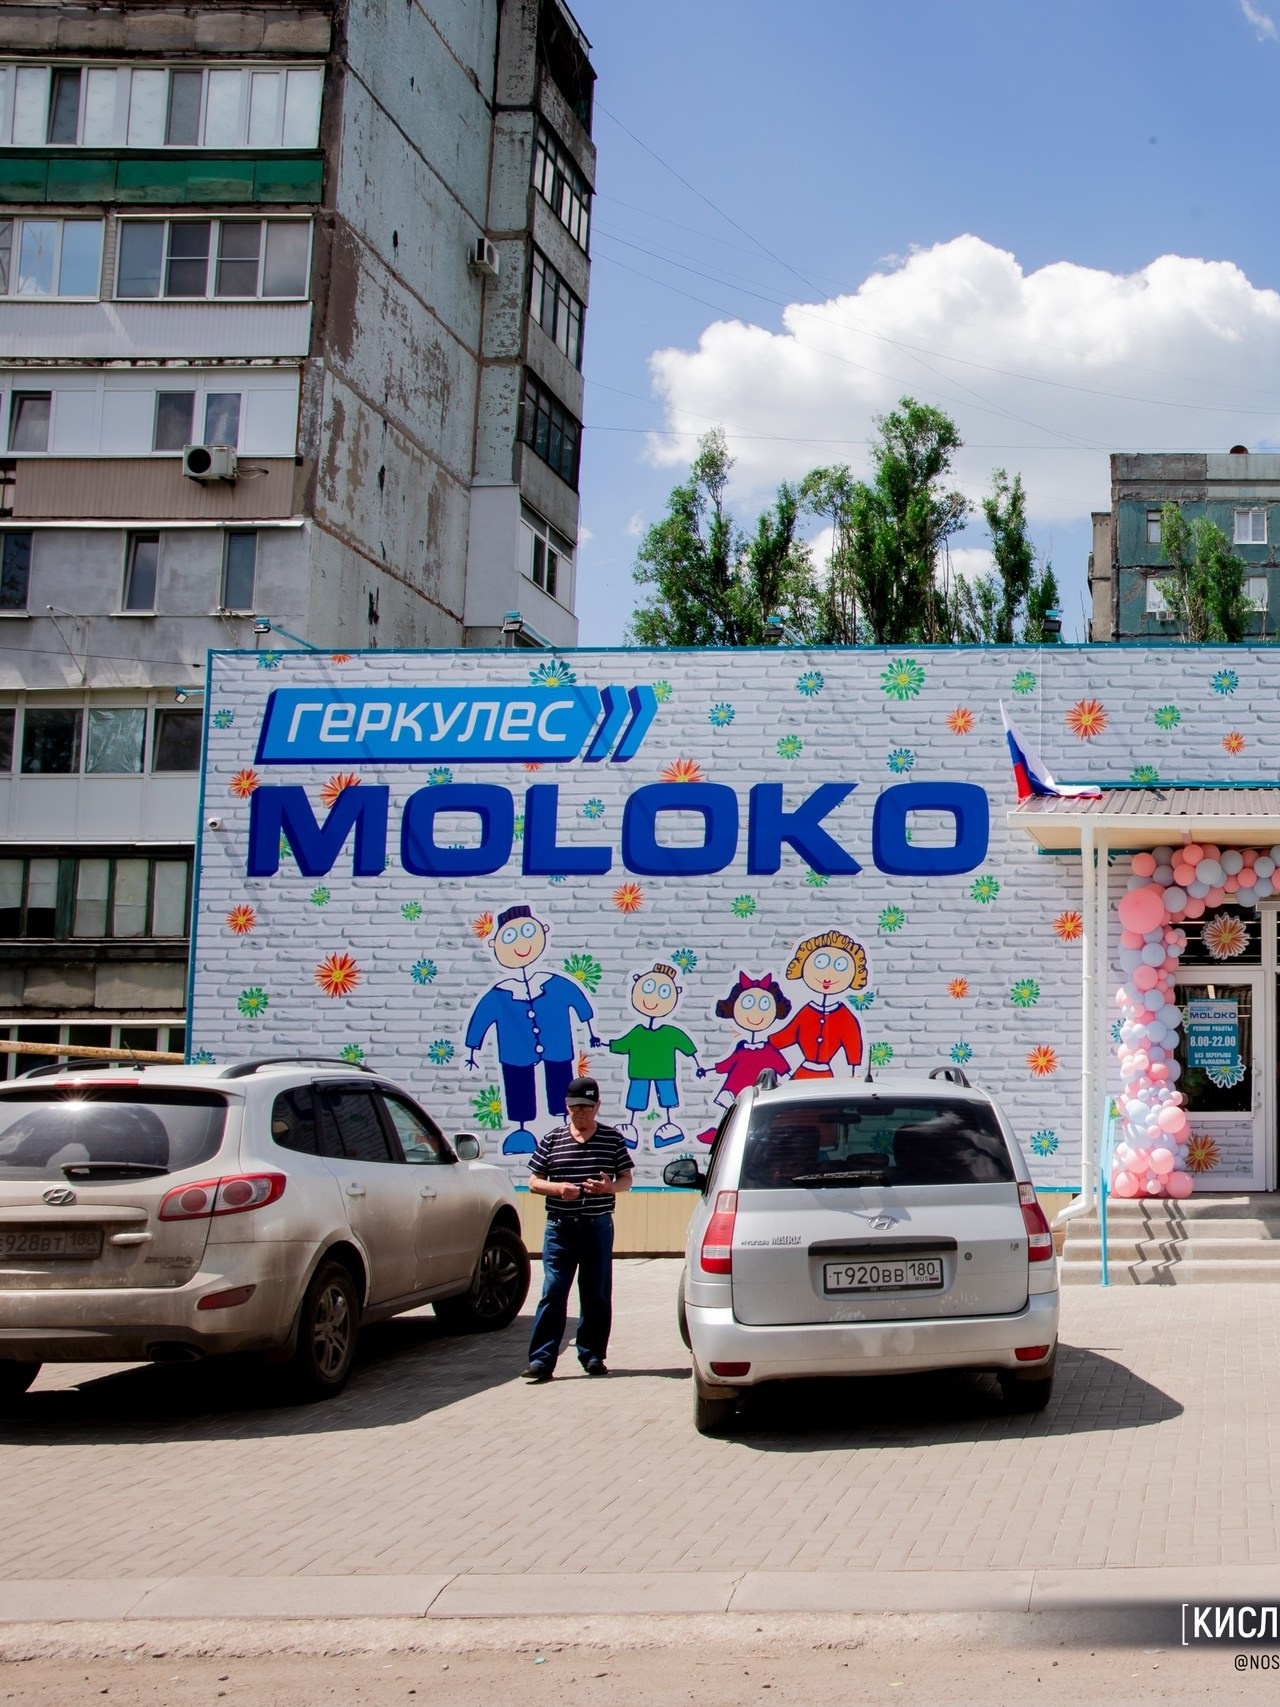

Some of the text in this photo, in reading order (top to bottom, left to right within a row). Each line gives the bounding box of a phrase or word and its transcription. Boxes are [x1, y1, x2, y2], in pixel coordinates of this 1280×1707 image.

[287, 700, 574, 744] ГЕРКУЛЕС
[247, 781, 989, 877] MOLOKO
[1190, 1036, 1236, 1047] 8.00-22.00
[832, 1262, 936, 1286] Т920ВВ 180
